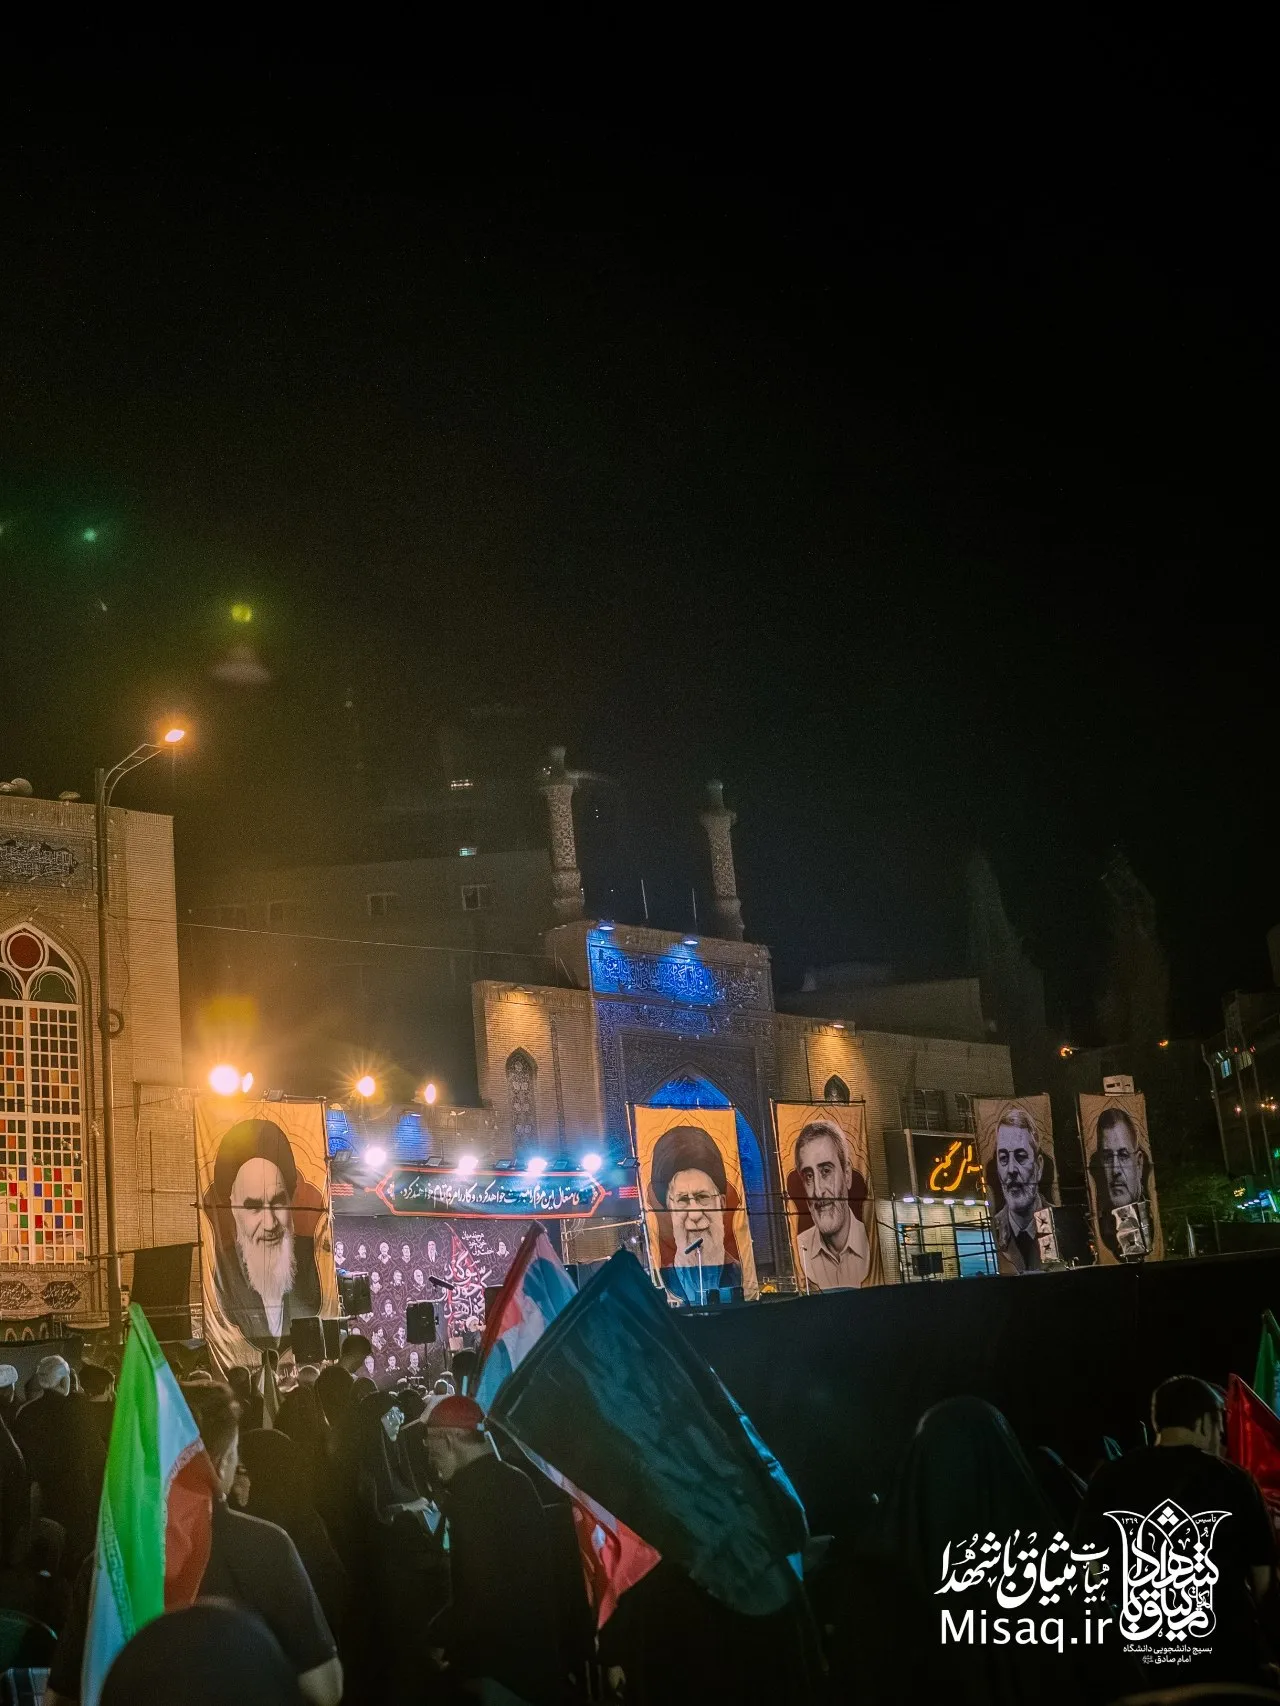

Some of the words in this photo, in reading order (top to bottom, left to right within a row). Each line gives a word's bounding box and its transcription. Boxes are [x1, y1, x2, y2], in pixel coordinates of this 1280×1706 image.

[462, 1183, 477, 1203] کار
[488, 1186, 505, 1203] خواهد
[533, 1185, 546, 1209] مردم
[541, 1190, 555, 1210] این
[553, 1186, 574, 1209] متعال
